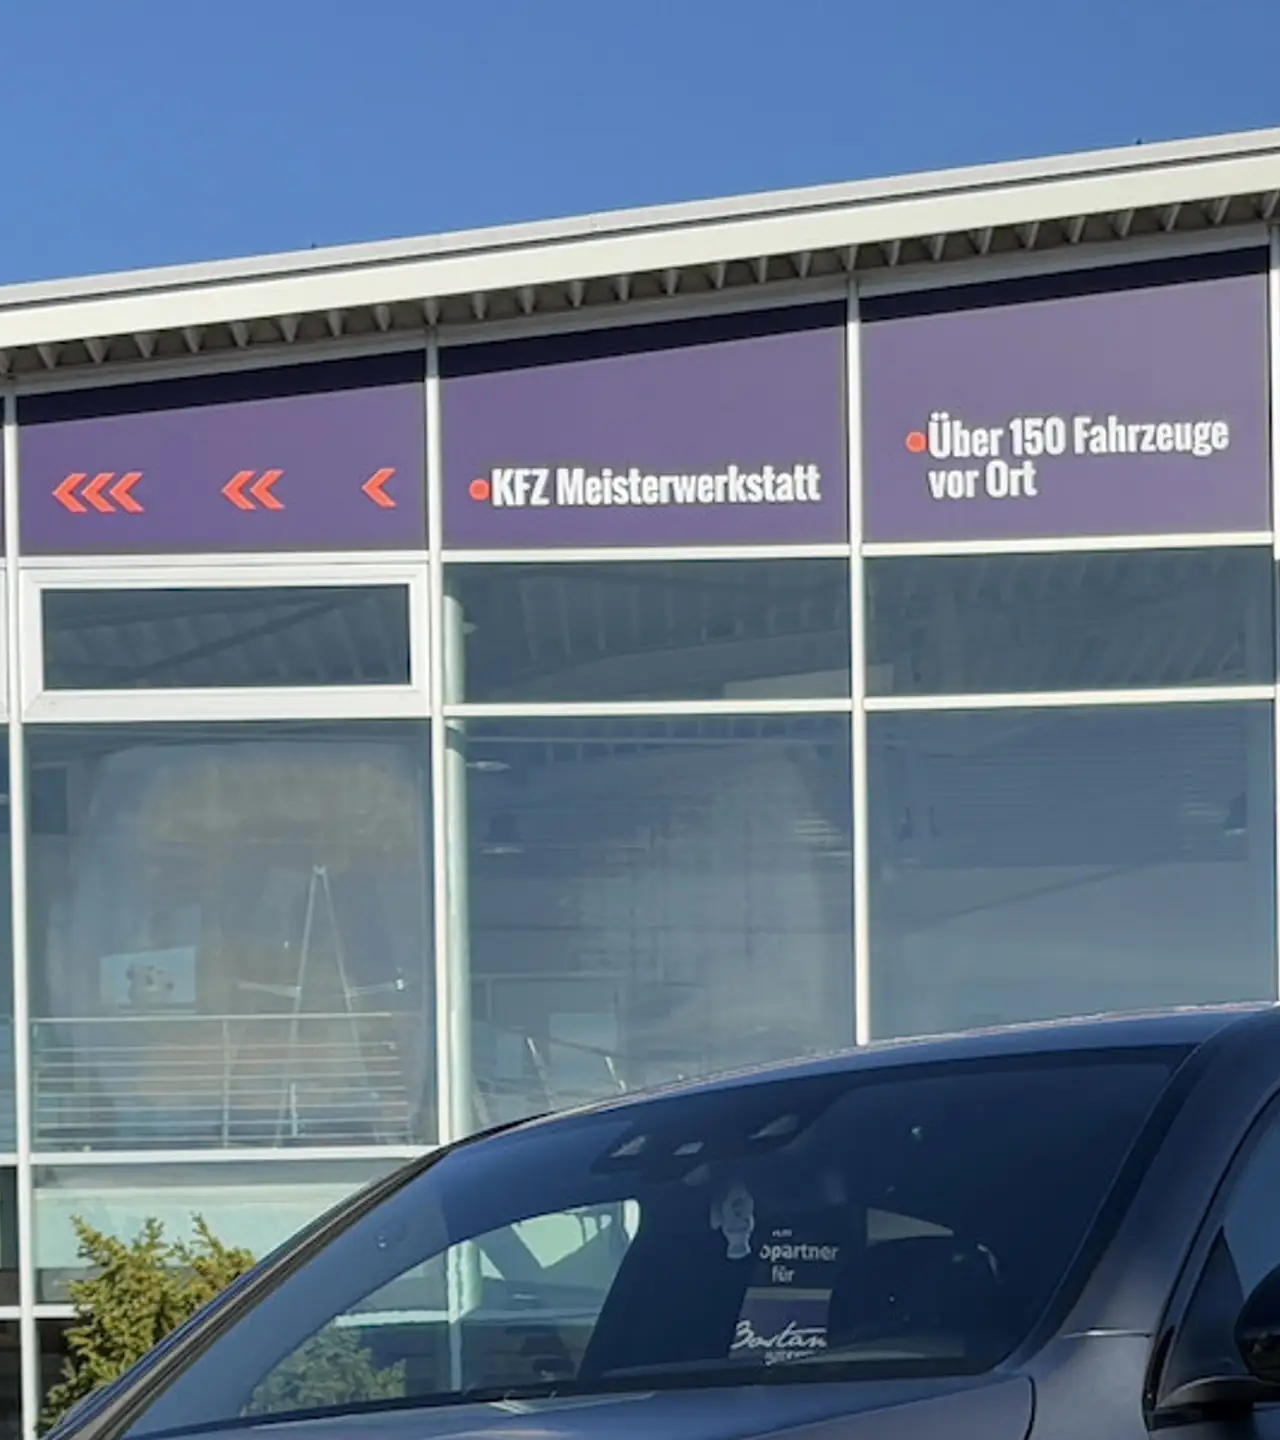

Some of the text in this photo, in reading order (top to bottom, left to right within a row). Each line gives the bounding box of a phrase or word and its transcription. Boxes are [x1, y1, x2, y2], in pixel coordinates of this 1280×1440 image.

[927, 411, 1230, 458] Über 150 Fahrzeuge
[491, 464, 821, 507] KFZ Meisterwerkstatt
[928, 459, 1039, 499] vor Ort
